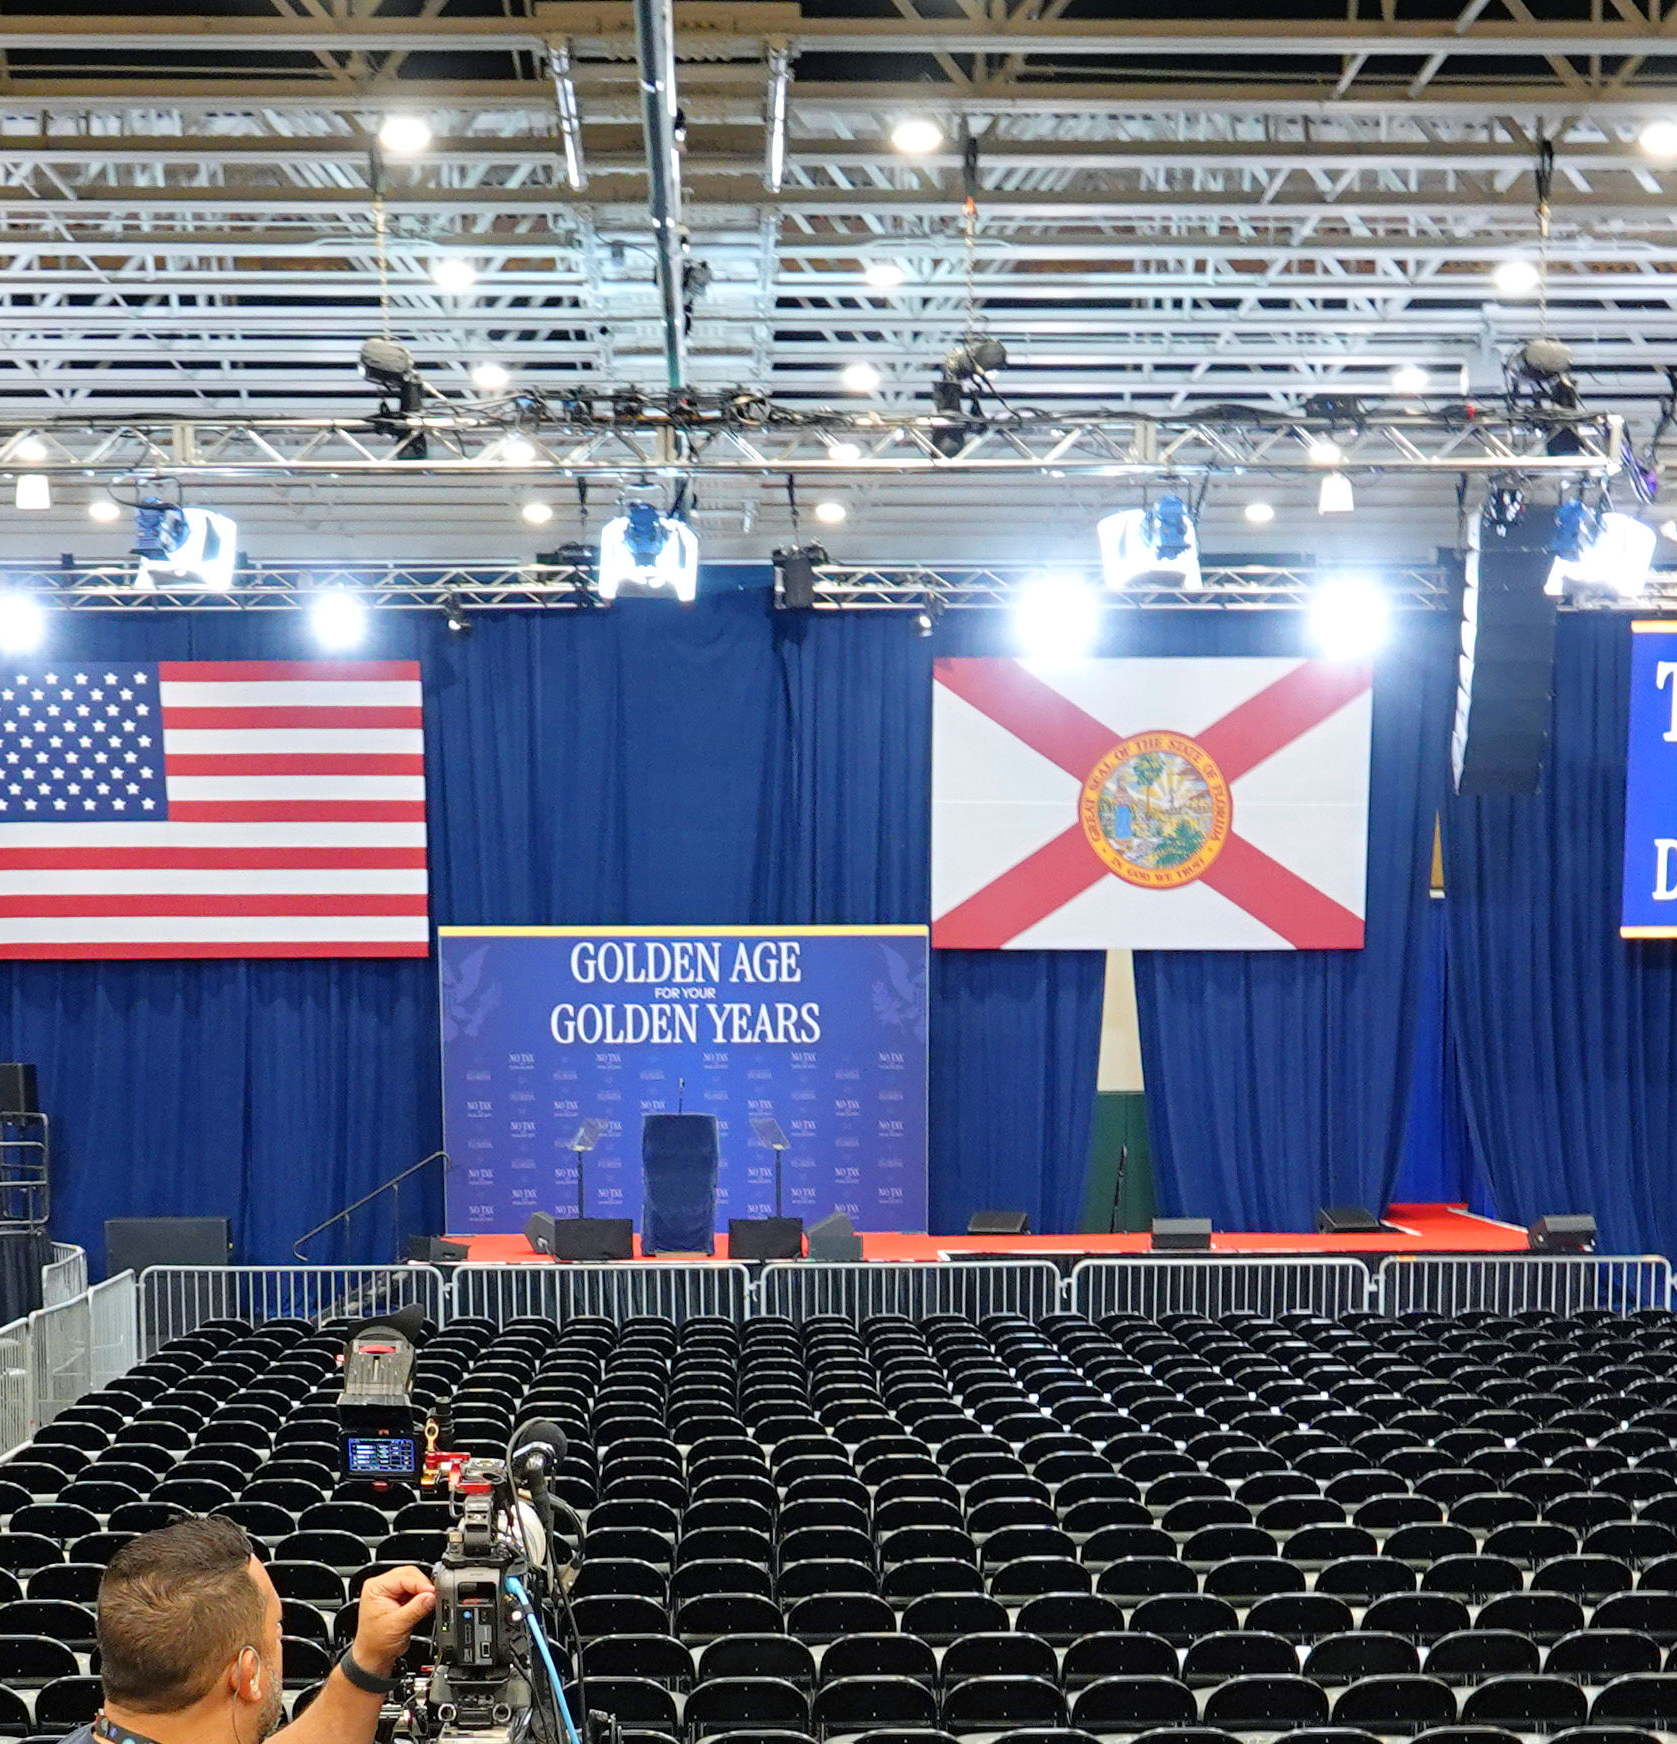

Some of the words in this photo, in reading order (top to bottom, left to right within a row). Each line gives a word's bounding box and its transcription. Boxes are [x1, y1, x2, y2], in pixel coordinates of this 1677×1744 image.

[571, 942, 721, 983] GOLDEN
[730, 942, 801, 982] AGE
[655, 988, 680, 998] FOR
[682, 988, 715, 998] YOUR
[551, 1004, 698, 1043] GOLDEN
[707, 1003, 820, 1043] YEARS
